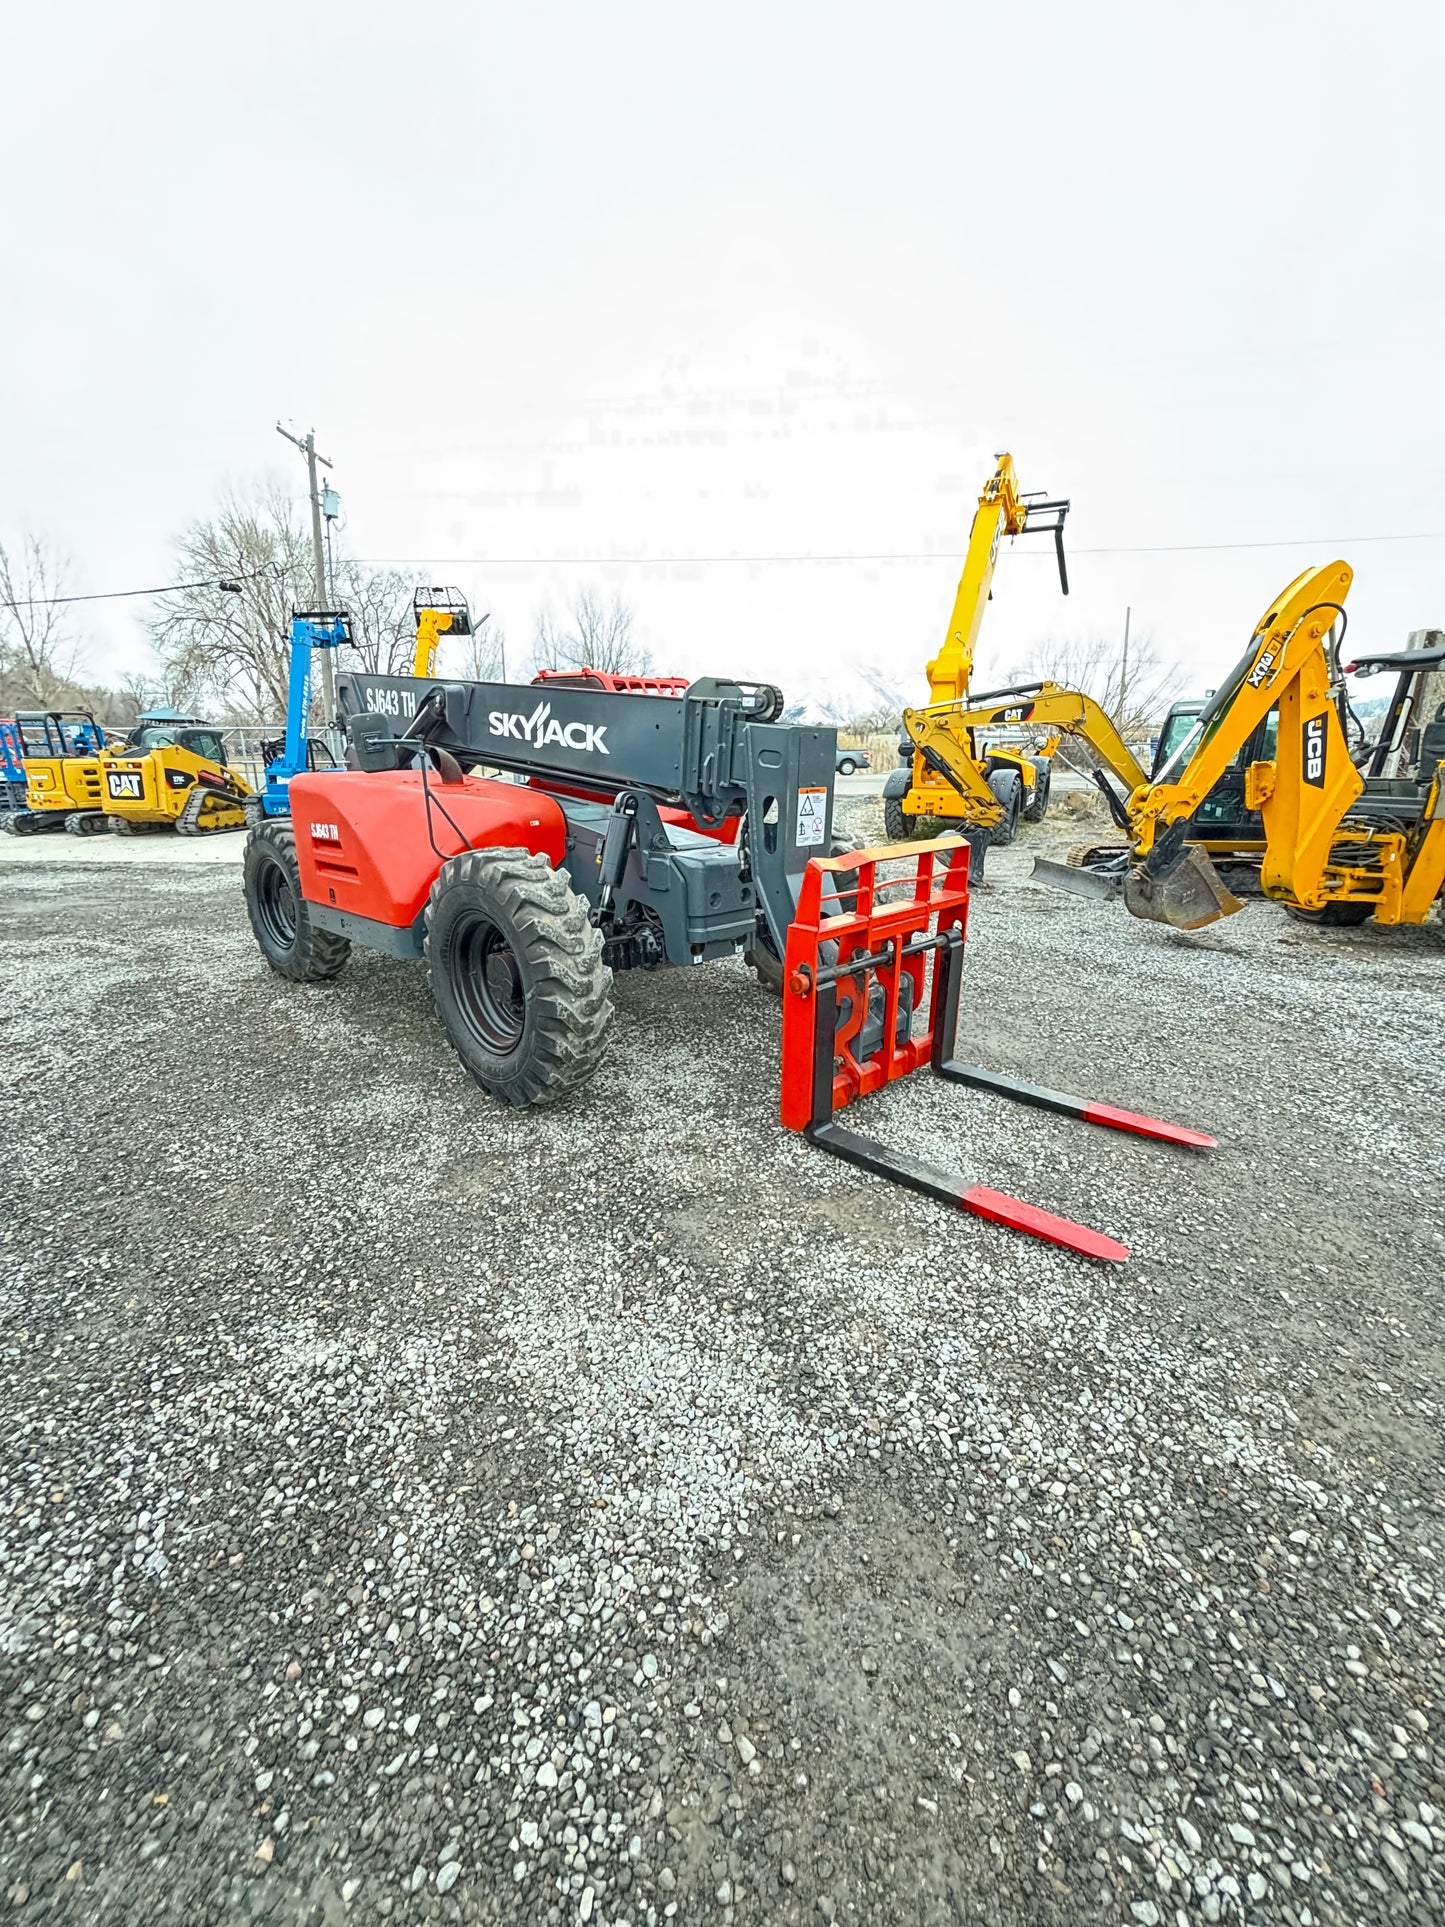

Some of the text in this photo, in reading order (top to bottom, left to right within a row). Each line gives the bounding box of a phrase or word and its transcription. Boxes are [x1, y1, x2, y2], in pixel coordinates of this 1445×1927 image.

[366, 687, 416, 718] SJ643 TH
[1004, 708, 1023, 721] CAT
[488, 701, 610, 755] SKYJACK
[1307, 720, 1322, 779] JCB
[108, 774, 141, 797] CAT
[310, 822, 339, 840] SJ643 TH
